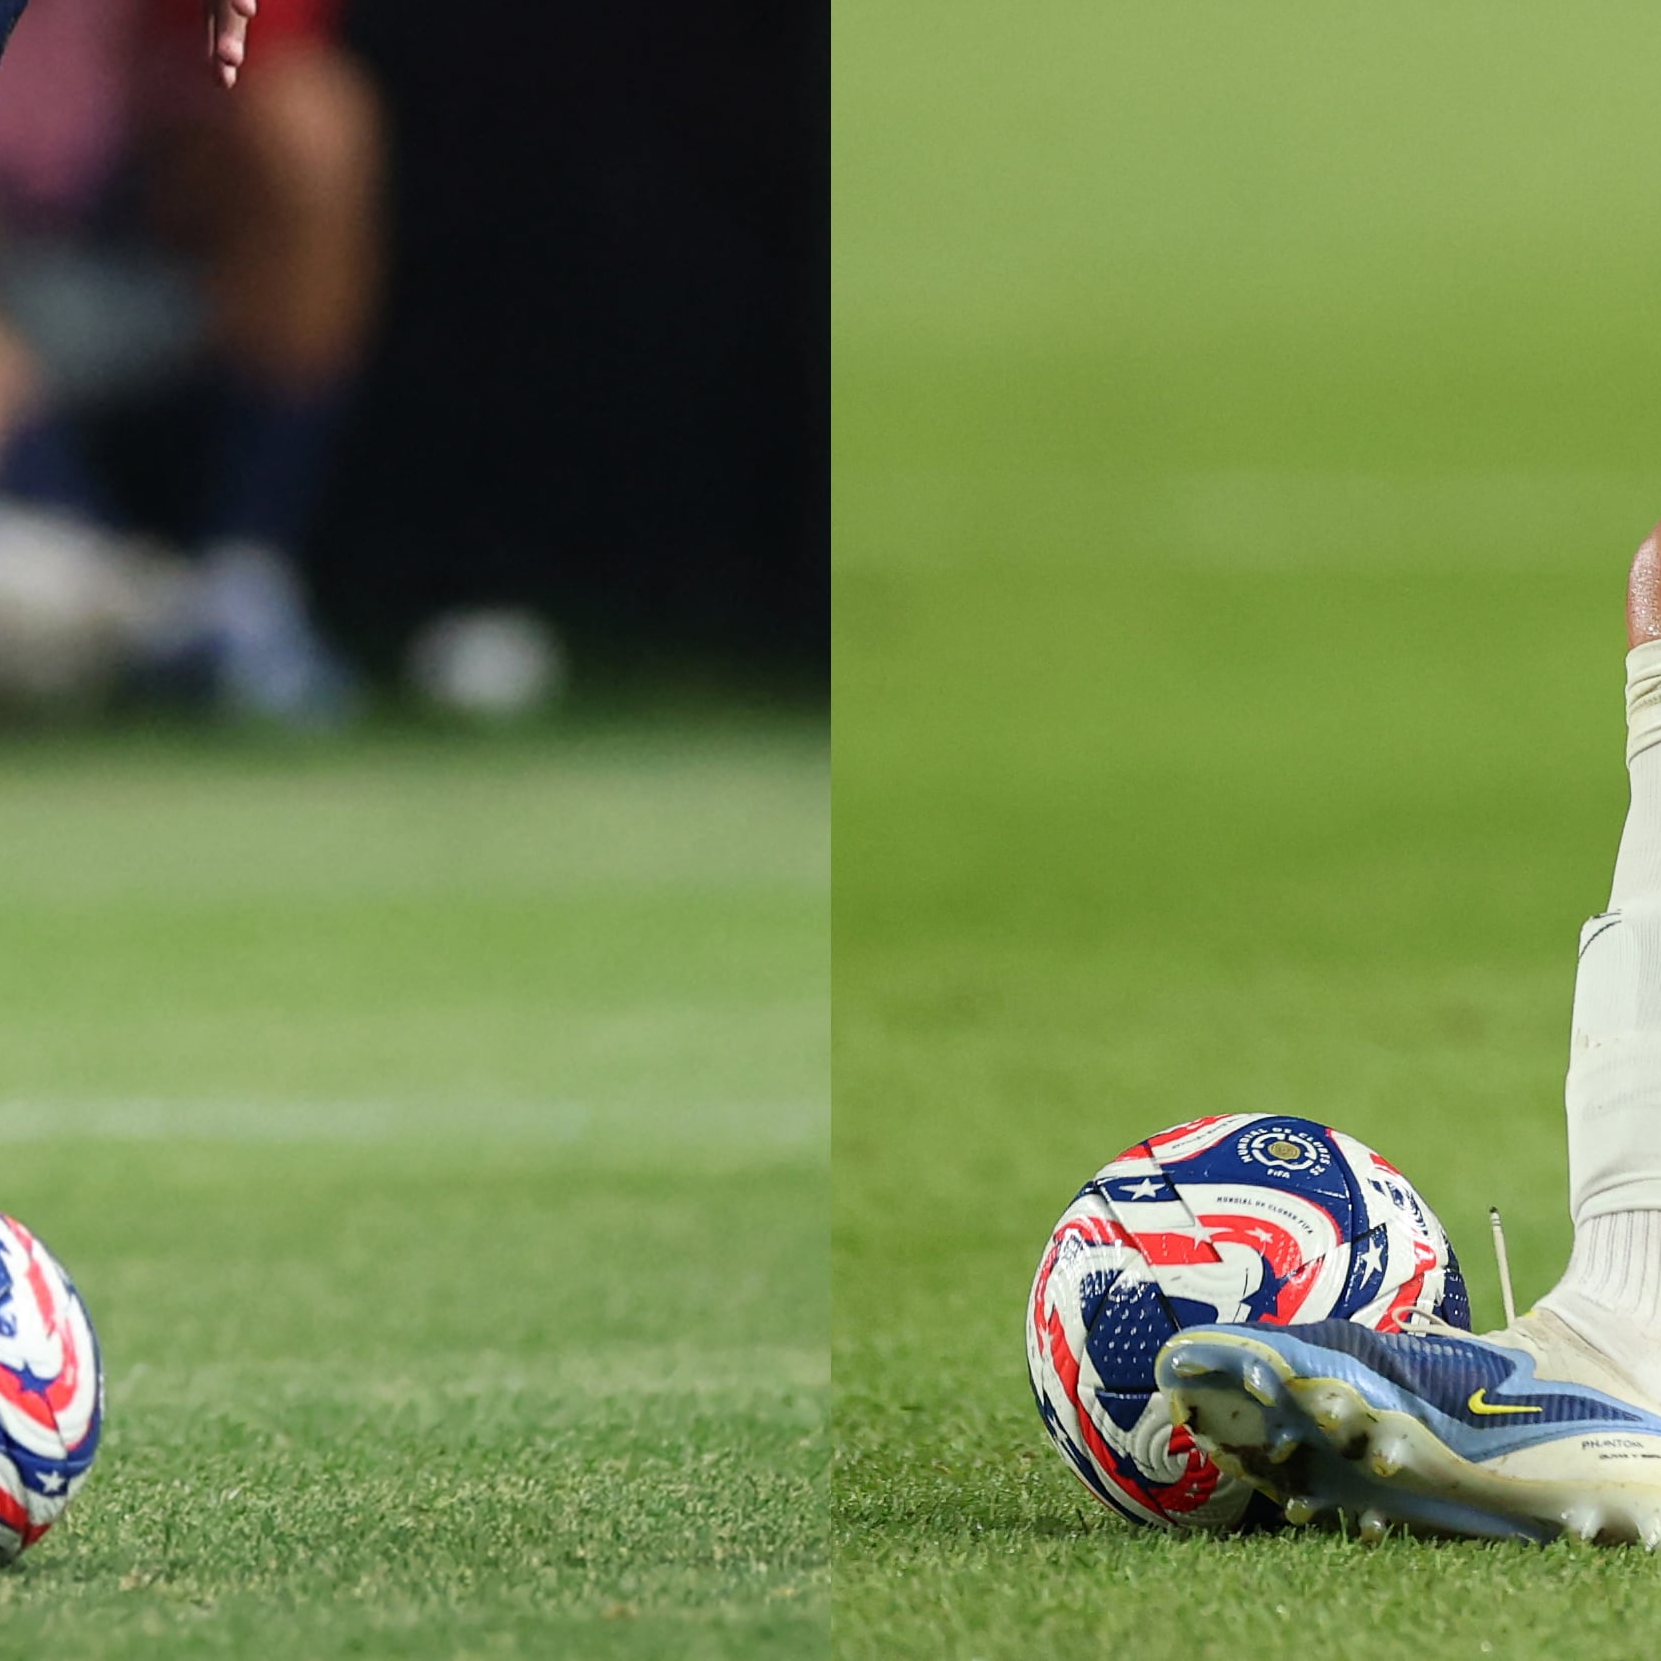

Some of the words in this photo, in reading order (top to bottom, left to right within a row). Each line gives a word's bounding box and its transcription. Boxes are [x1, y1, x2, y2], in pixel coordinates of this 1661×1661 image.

[1237, 1128, 1268, 1163] MUNDIAL
[1298, 1132, 1331, 1165] CLUBES
[1266, 1168, 1291, 1179] FIFA
